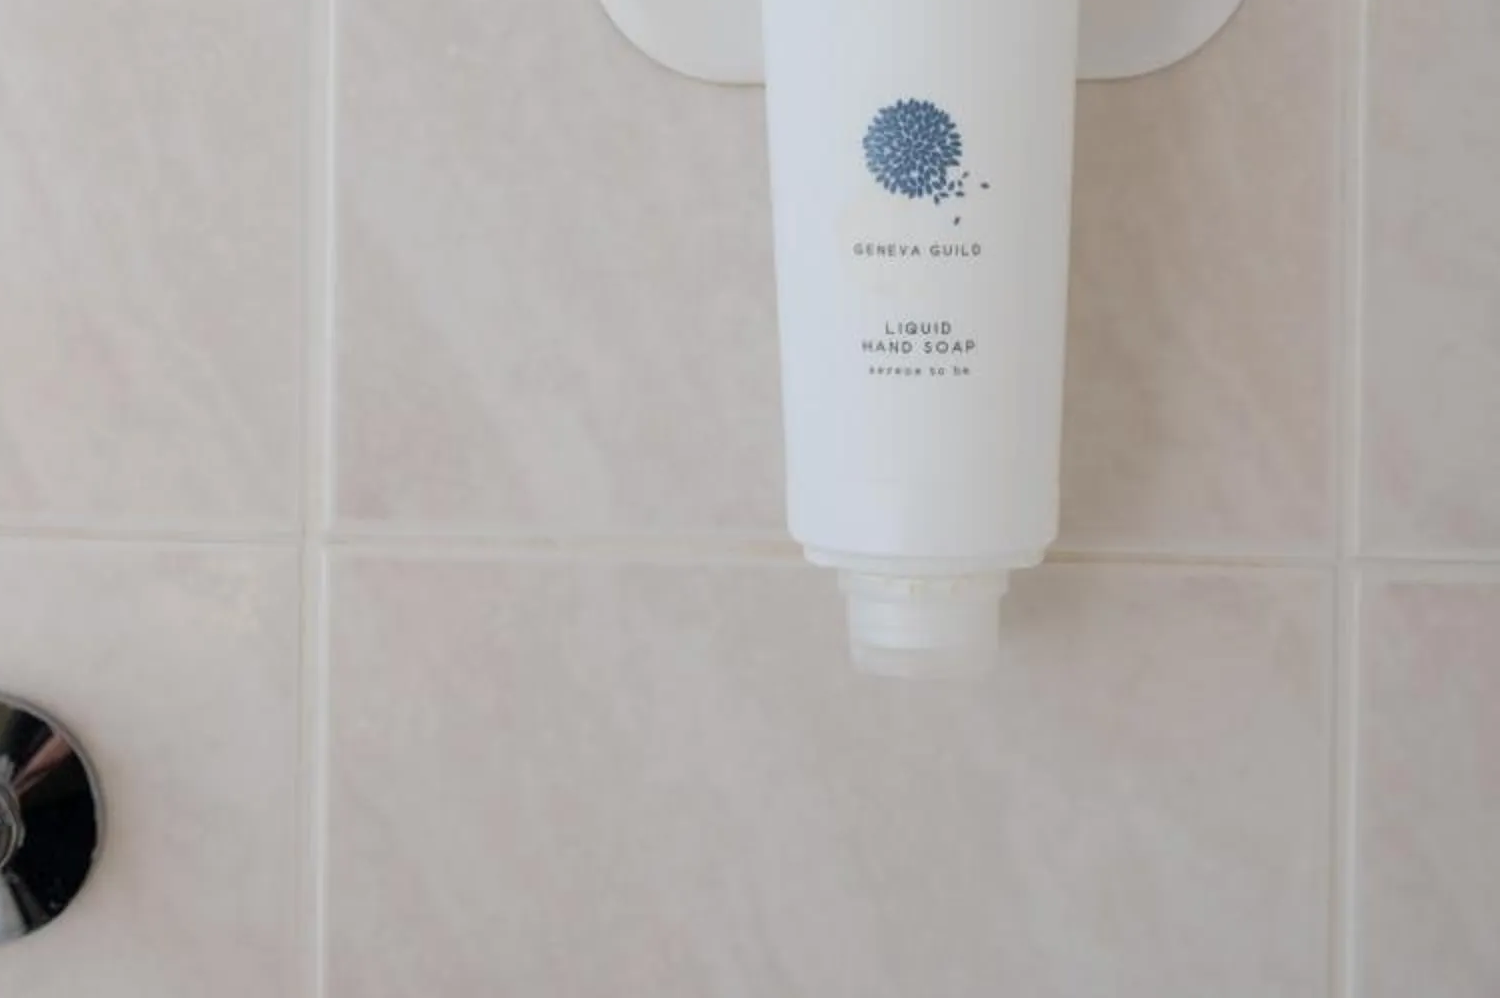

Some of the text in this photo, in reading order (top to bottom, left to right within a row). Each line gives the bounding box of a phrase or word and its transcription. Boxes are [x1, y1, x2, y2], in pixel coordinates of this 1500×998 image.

[853, 243, 981, 257] GENEVA GUILD
[885, 321, 951, 335] LIQUID
[862, 339, 975, 354] HAND SOAP
